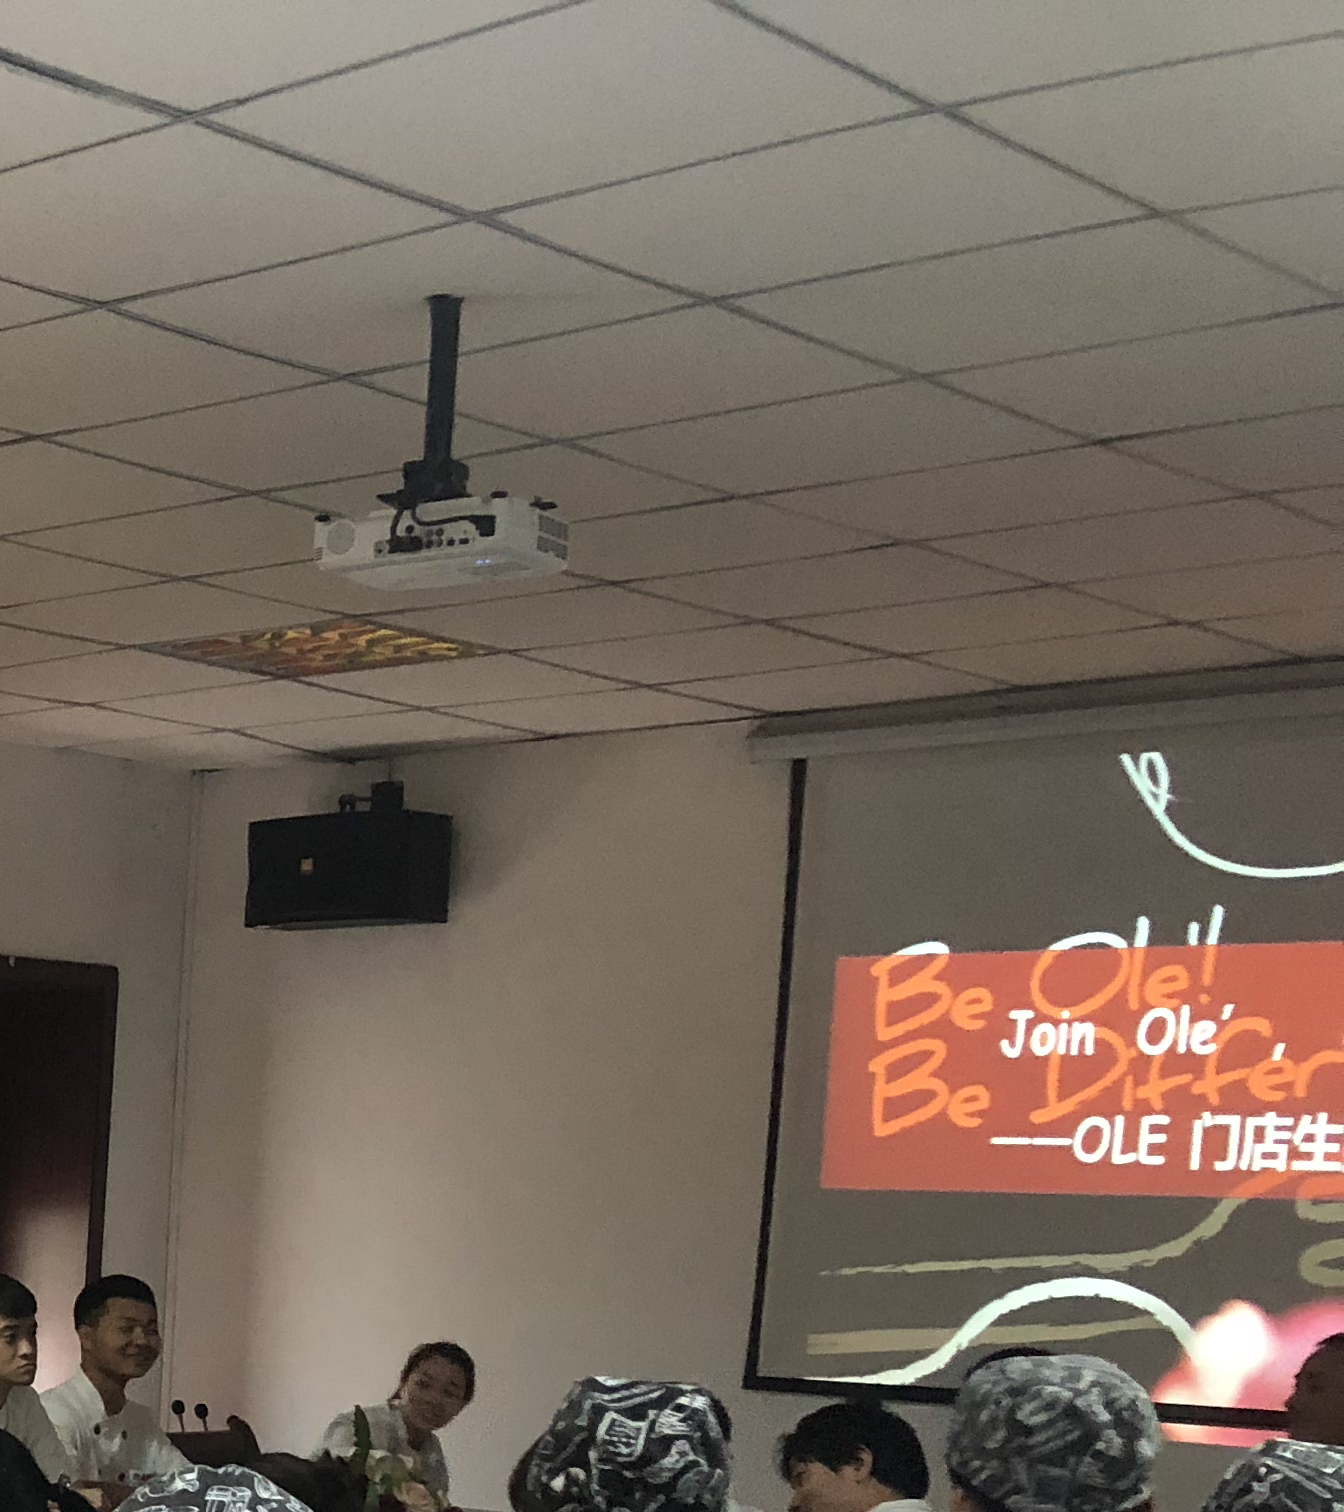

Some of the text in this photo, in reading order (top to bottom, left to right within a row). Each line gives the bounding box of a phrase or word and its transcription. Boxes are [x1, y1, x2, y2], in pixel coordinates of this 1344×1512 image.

[870, 941, 994, 1041] Be
[1000, 1009, 1096, 1059] Join
[868, 1037, 991, 1137] Be
